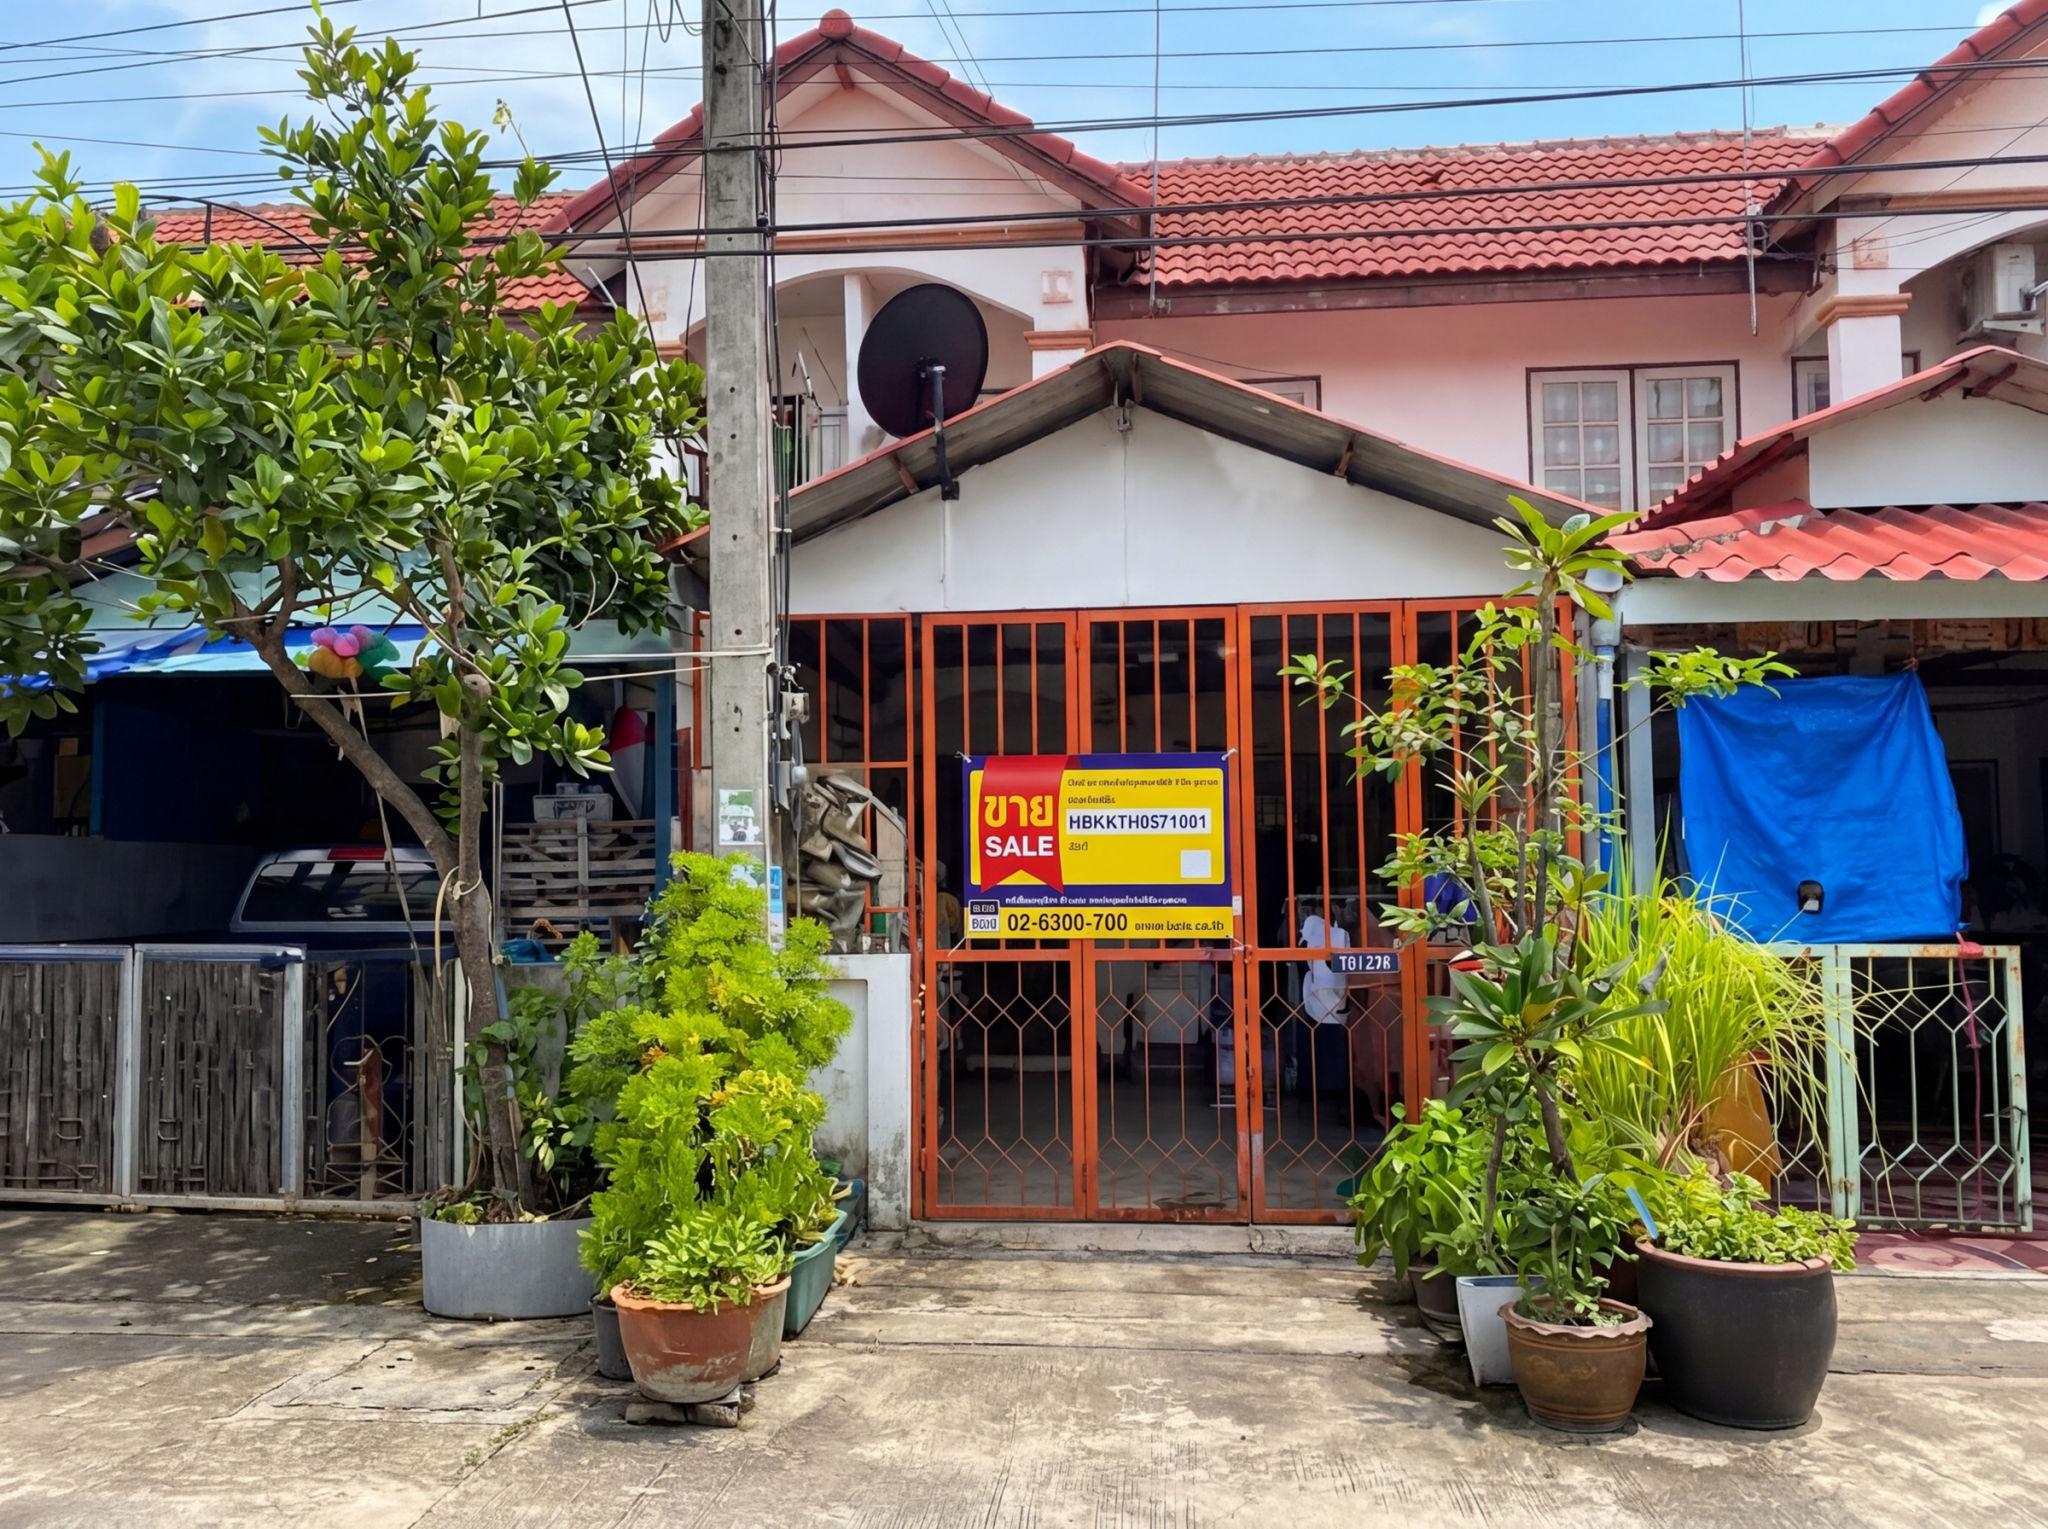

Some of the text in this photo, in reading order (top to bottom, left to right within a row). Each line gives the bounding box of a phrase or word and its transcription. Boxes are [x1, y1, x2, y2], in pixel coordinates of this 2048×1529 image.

[984, 795, 1054, 828] ขาย
[985, 835, 1054, 857] SALE
[1007, 913, 1128, 931] 02-6300-700
